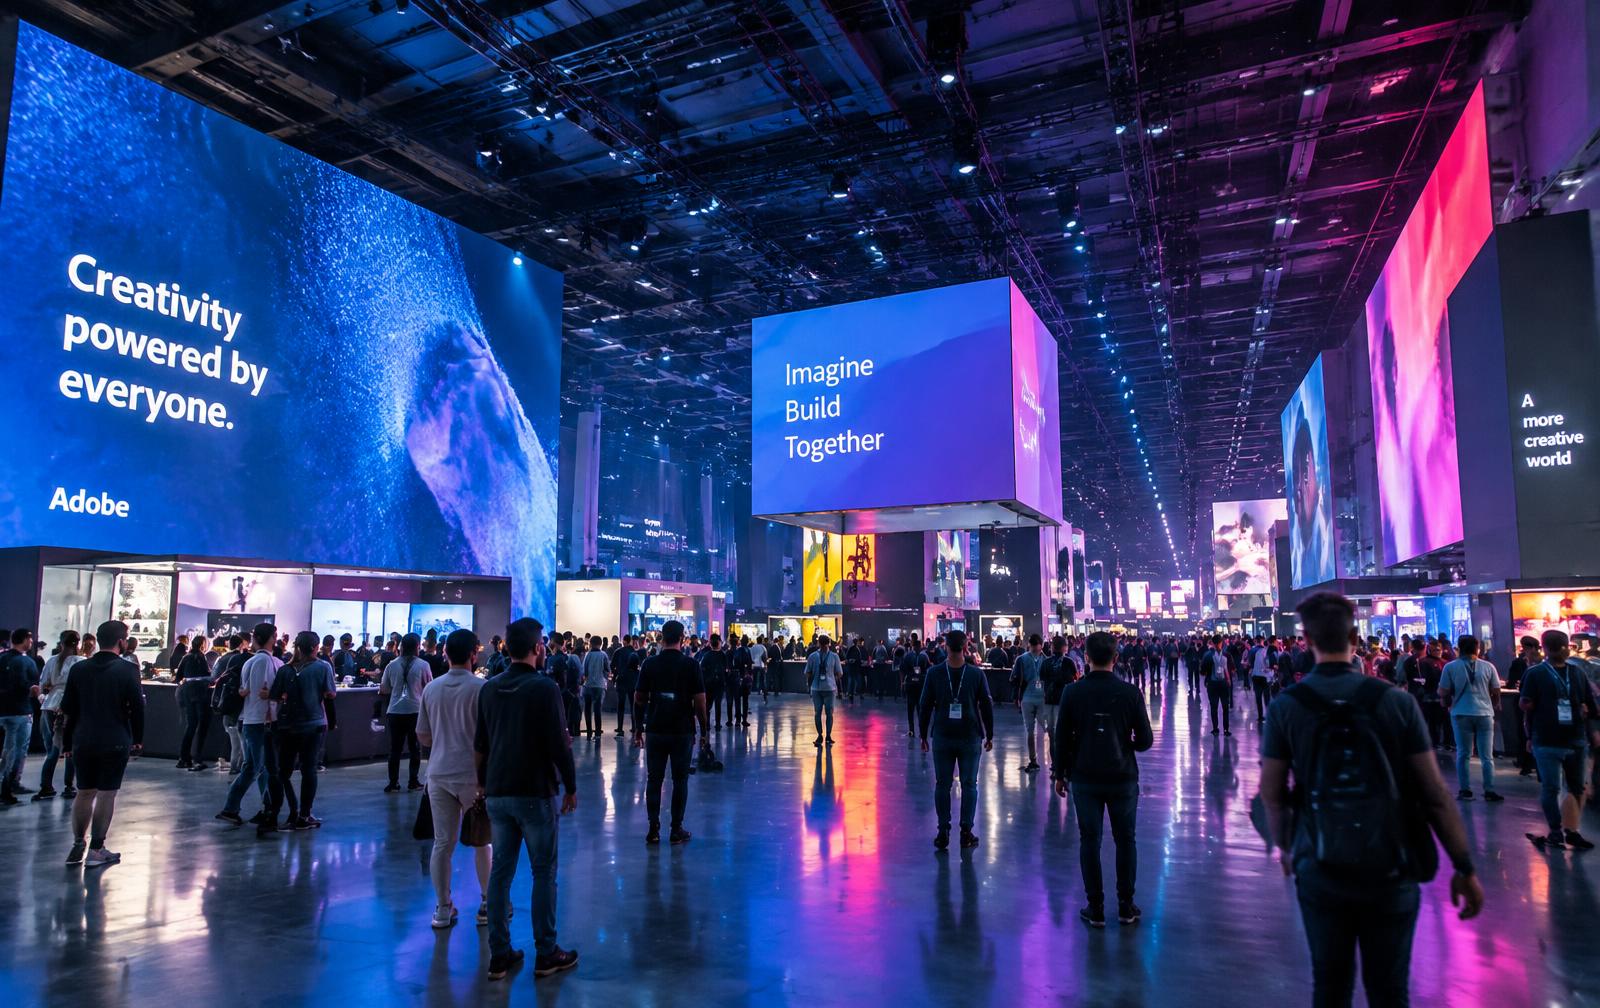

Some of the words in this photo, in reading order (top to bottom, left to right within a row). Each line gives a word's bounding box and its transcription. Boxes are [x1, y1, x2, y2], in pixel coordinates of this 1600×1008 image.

[68, 254, 242, 342] Creativity
[63, 314, 222, 379] powered
[230, 350, 269, 397] by
[785, 356, 875, 388] Imagine
[59, 370, 234, 430] everyone.
[785, 395, 842, 422] Build
[1521, 393, 1535, 408] A
[1523, 414, 1565, 429] more
[784, 430, 885, 464] Together
[1523, 430, 1585, 448] creative
[1525, 449, 1572, 468] world
[48, 487, 130, 518] Adobe
